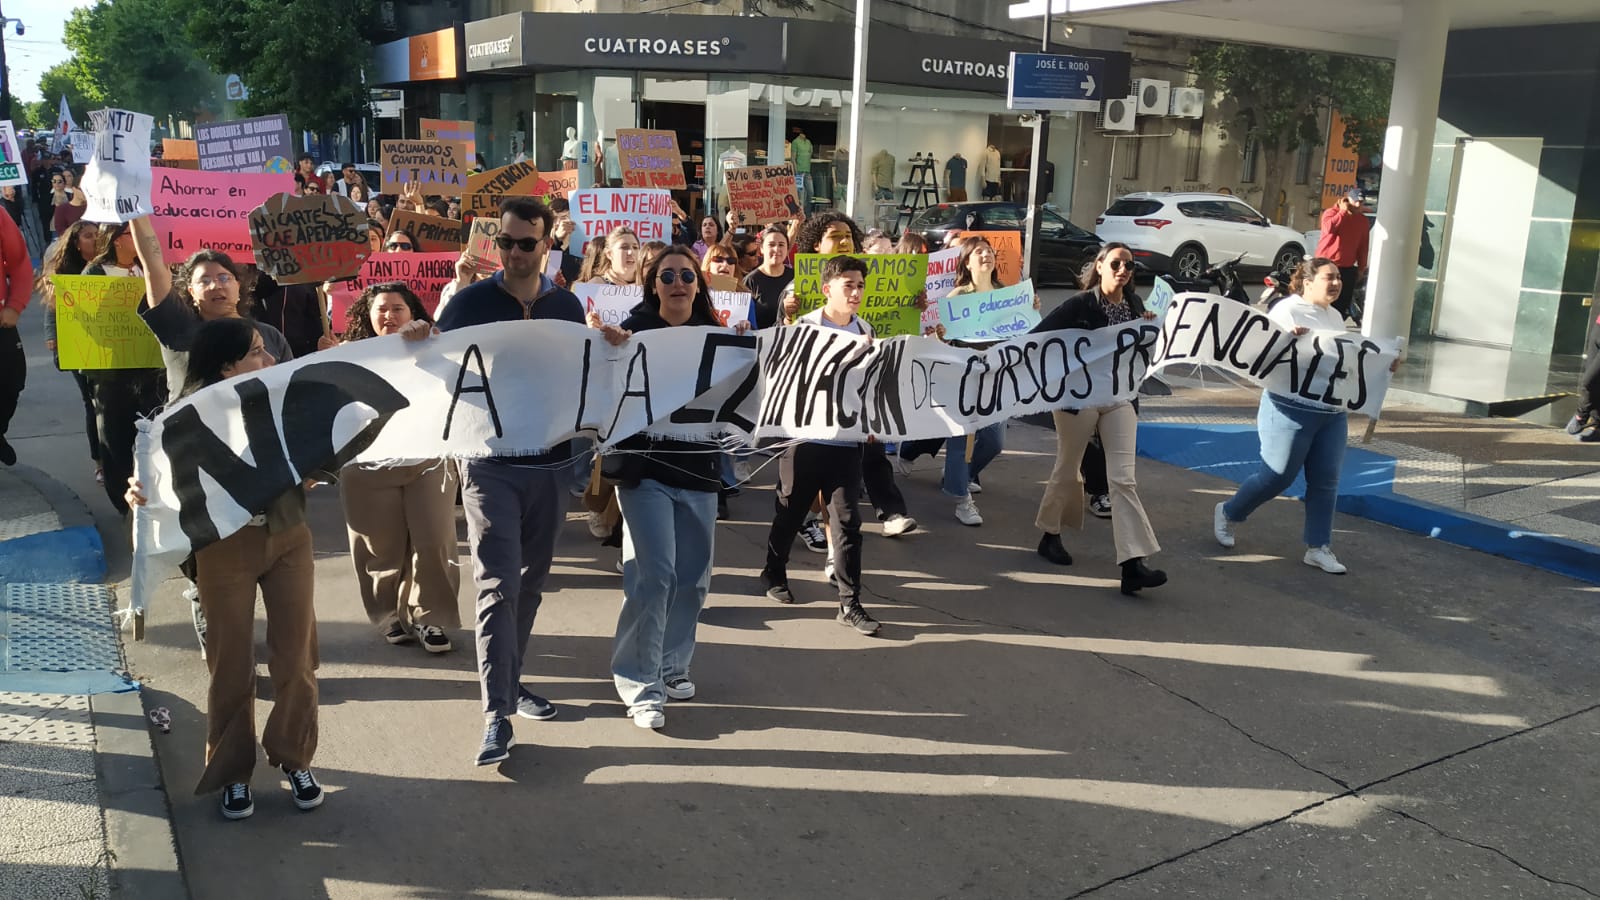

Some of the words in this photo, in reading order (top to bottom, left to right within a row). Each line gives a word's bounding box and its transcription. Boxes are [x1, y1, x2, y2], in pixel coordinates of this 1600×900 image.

[921, 58, 1009, 79] CUATROAS
[1036, 58, 1057, 69] JOSÉ
[1059, 62, 1067, 70] E.
[1069, 61, 1089, 71] RODÓ
[197, 128, 209, 140] LOS
[244, 123, 253, 134] NO
[426, 129, 435, 138] EN
[199, 144, 206, 155] EL
[263, 136, 267, 147] A
[268, 134, 280, 146] LAS
[384, 143, 453, 157] VACUNADOS
[201, 155, 233, 170] PERSONAS
[234, 153, 246, 167] QUE
[247, 151, 260, 163] VAN
[262, 150, 267, 162] A
[391, 154, 435, 165] CONTRA
[441, 158, 458, 168] LA
[1331, 159, 1355, 172] TODO
[160, 175, 219, 195] Ahorrar
[229, 187, 246, 197] en
[153, 203, 236, 218] educación
[578, 194, 607, 214] EL
[611, 193, 672, 216] INTERIOR
[277, 202, 331, 226] CARTEL
[168, 231, 183, 250] la
[263, 229, 294, 247] CAE
[262, 247, 292, 268] POR
[347, 280, 363, 291] EN
[876, 277, 899, 292] EN
[947, 301, 970, 321] La
[980, 291, 1029, 313] educación
[109, 311, 130, 321] NOS
[992, 316, 1028, 334] vende
[162, 360, 410, 549] NO
[442, 343, 503, 441] A
[575, 337, 654, 442] LA
[911, 359, 952, 411] DE
[958, 336, 1093, 417] CURSOS
[1112, 297, 1381, 411] PRSENCIALES
